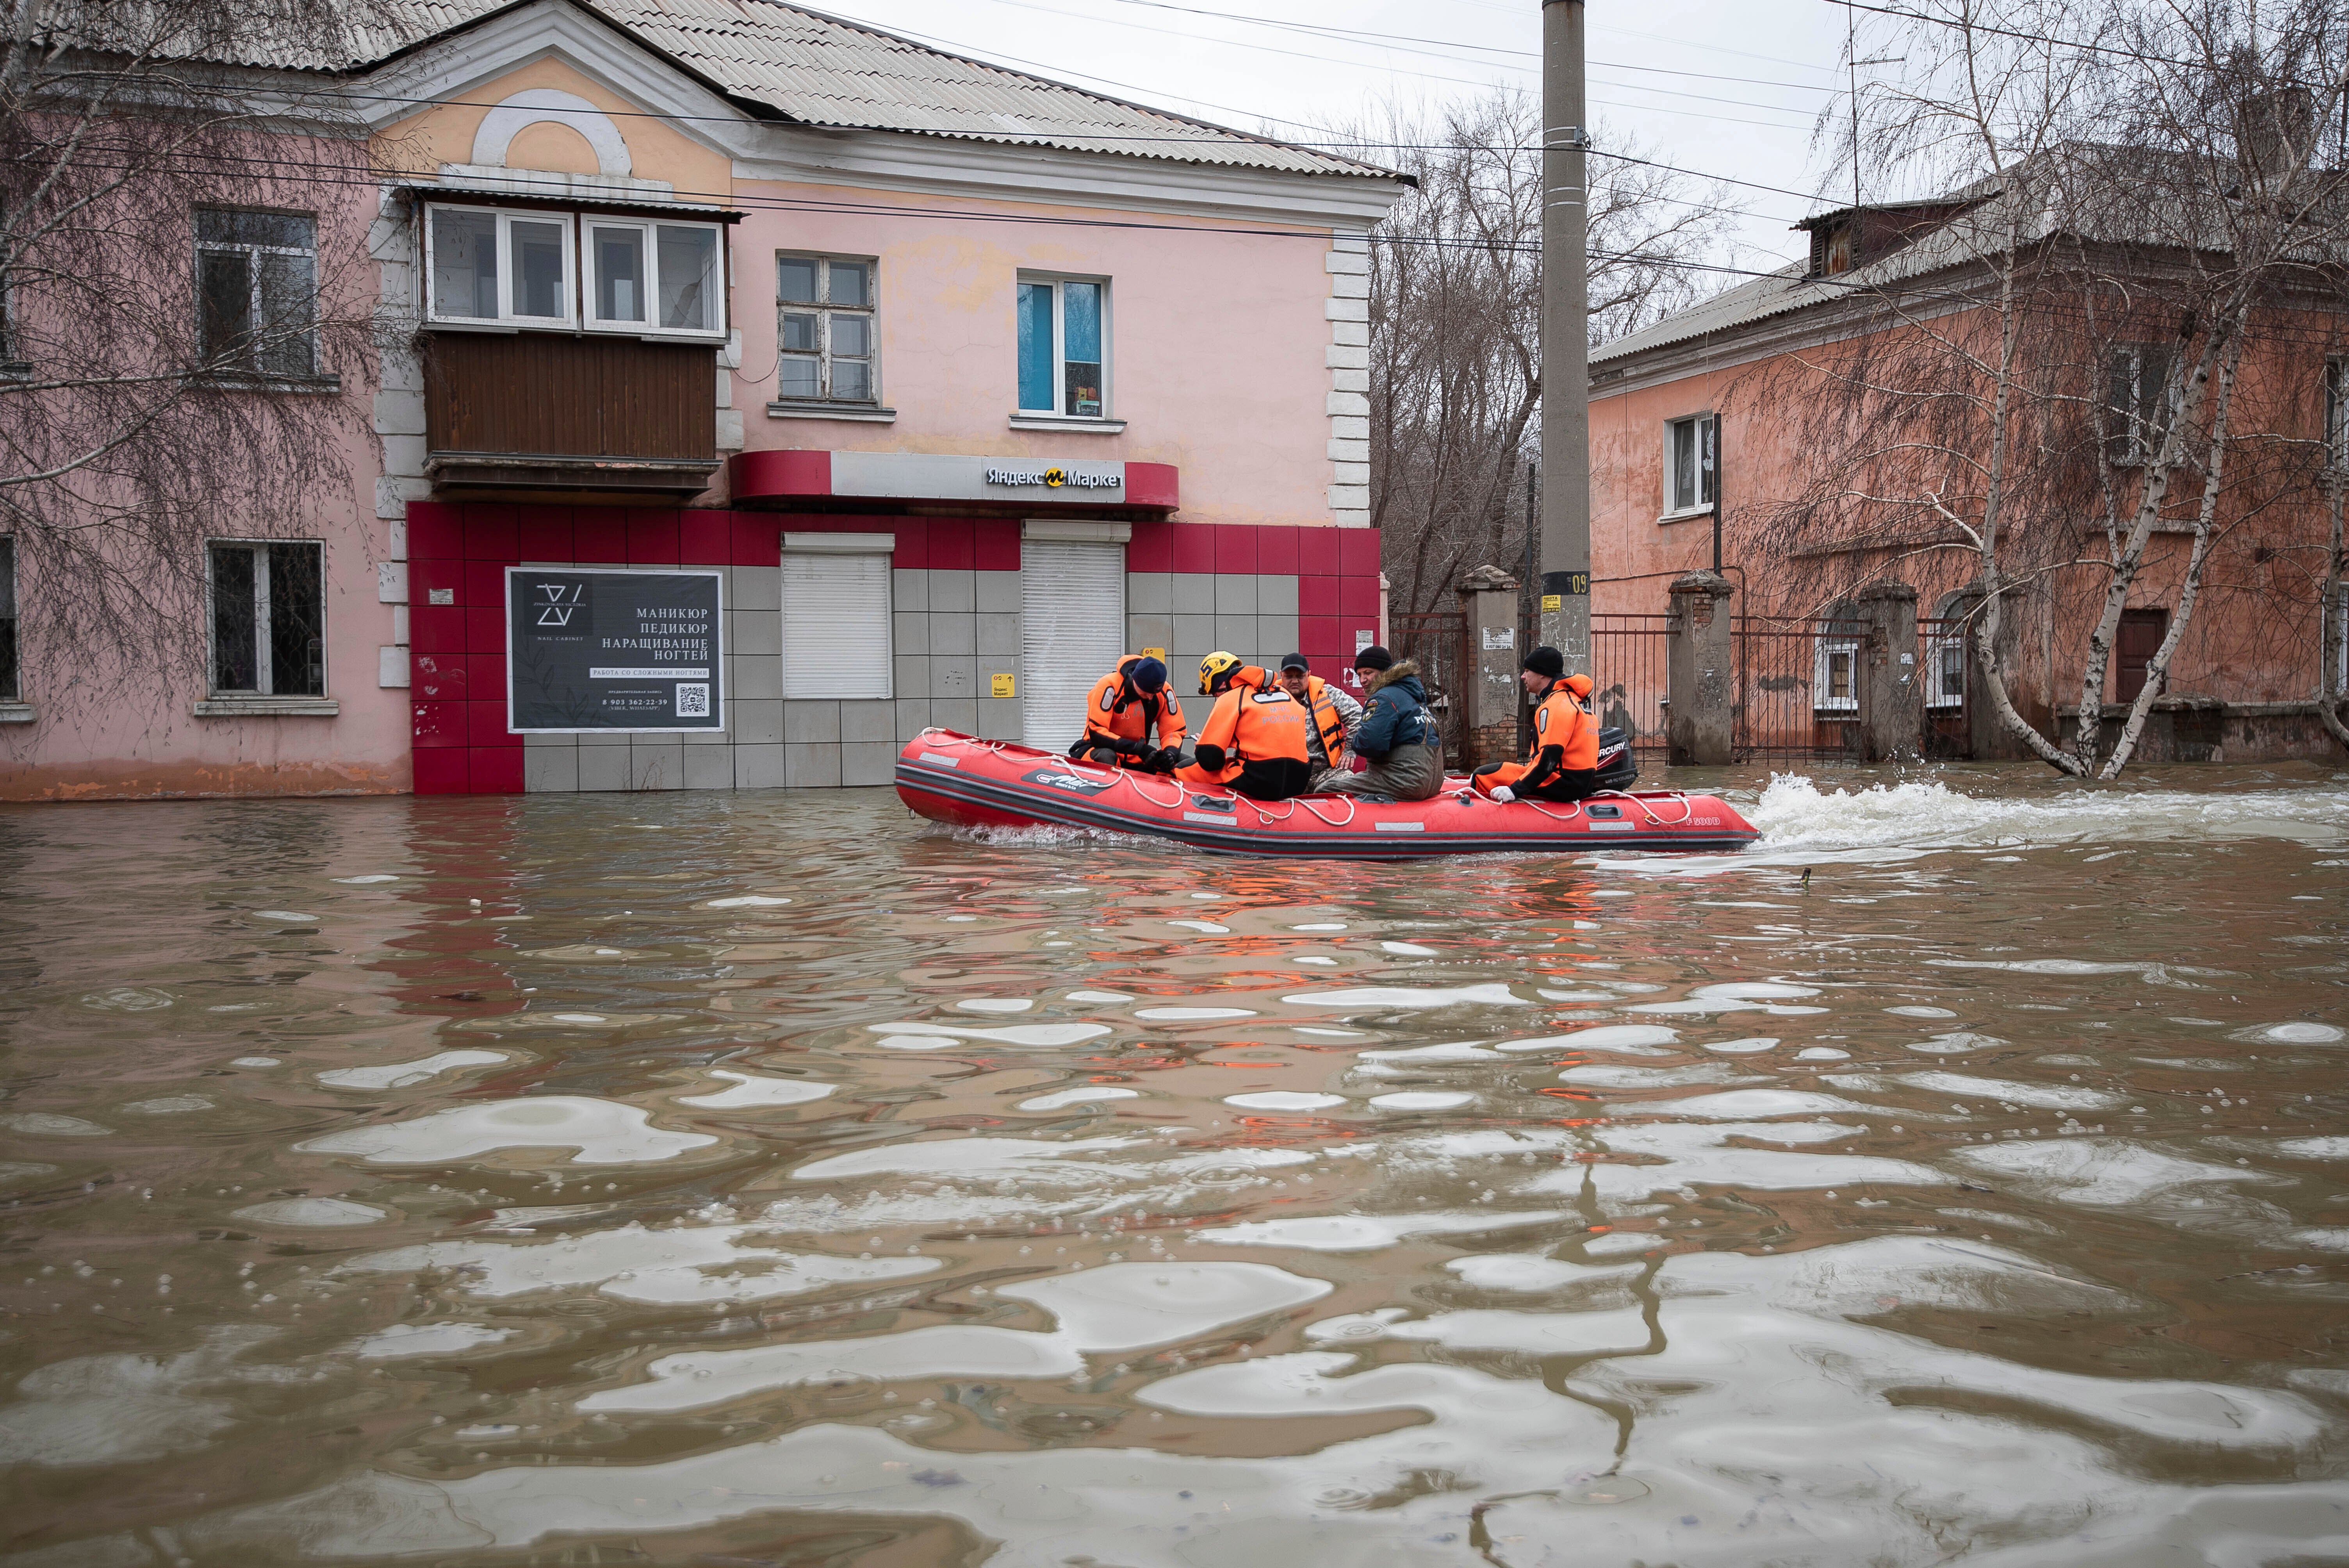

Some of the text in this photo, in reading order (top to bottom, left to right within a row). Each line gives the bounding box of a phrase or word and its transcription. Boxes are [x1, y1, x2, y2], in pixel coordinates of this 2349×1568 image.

[987, 468, 1043, 486] Яндекс
[1066, 470, 1124, 488] Маркет
[1572, 574, 1586, 593] 09
[637, 608, 708, 618] МАНИКЮР
[640, 624, 708, 635] ПЕДИКЮР
[602, 638, 708, 650] НАРАЩИВАНИЕ
[654, 648, 708, 660] НОГТЕЙ
[1598, 741, 1625, 757] RCURY
[1686, 817, 1720, 825] F 500D
